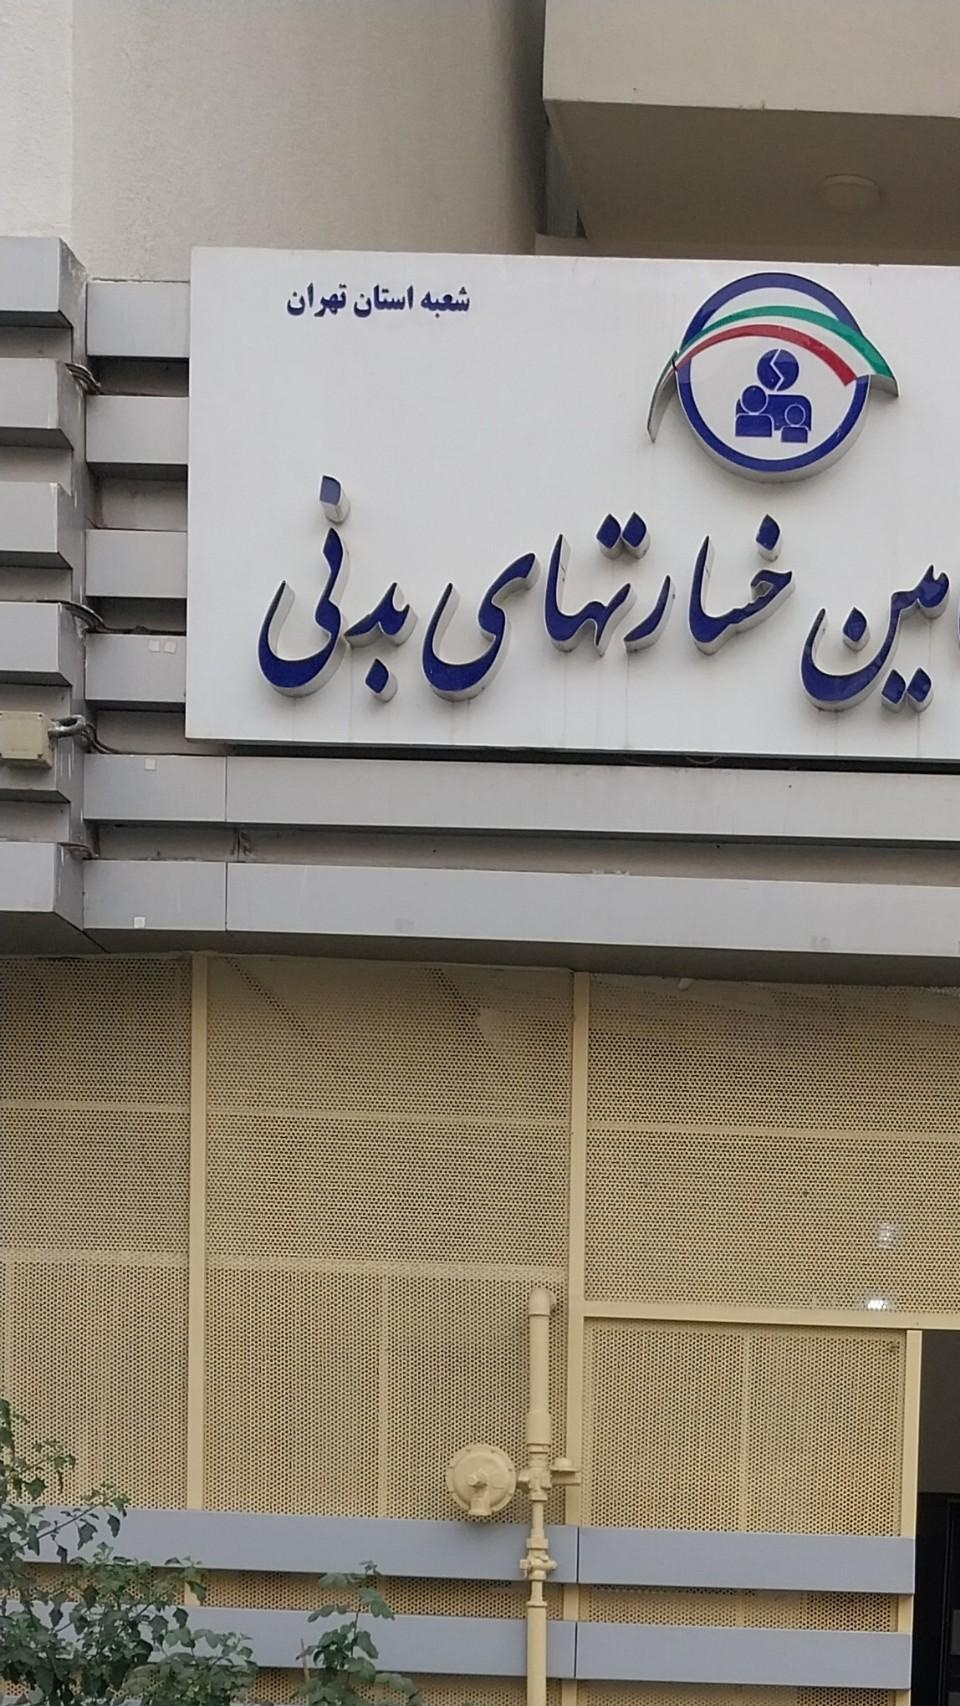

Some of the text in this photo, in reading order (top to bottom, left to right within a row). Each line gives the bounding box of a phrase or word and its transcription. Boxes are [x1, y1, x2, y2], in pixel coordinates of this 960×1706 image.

[287, 282, 470, 318] شعبه استان تهران
[257, 475, 417, 701] بدنی
